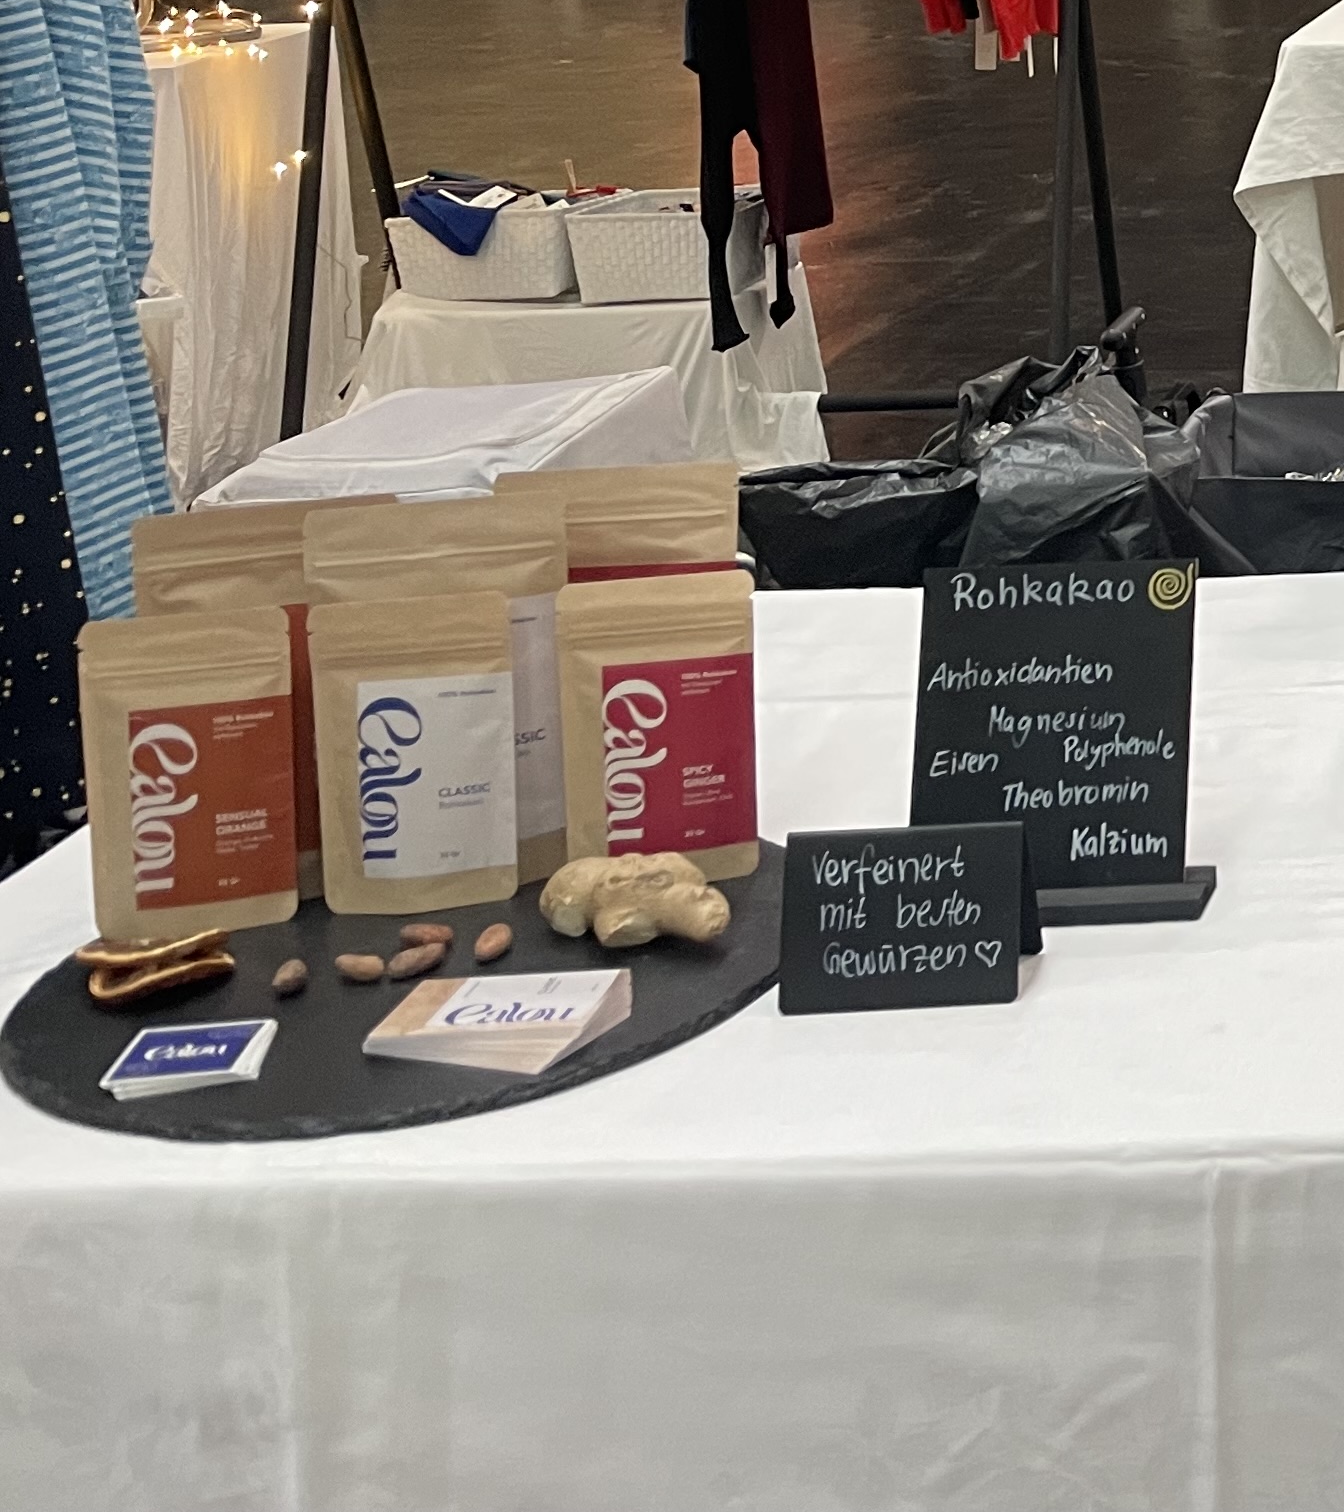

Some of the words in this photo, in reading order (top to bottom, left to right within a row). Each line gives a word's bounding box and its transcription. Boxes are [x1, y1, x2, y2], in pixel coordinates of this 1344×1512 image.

[950, 573, 1135, 611] Rohkakao
[927, 654, 1113, 692] Antioxidantien
[988, 707, 1126, 747] Magnesium
[929, 750, 999, 778] Eisen
[1063, 729, 1176, 769] Polyphenole
[438, 782, 491, 798] CLASSIC
[1003, 776, 1149, 812] Theobromin
[1070, 827, 1168, 861] Kalzium
[811, 844, 965, 895] Verfeinert
[820, 896, 867, 931] mit
[896, 890, 981, 929] besten
[823, 941, 967, 977] Gewürzen
